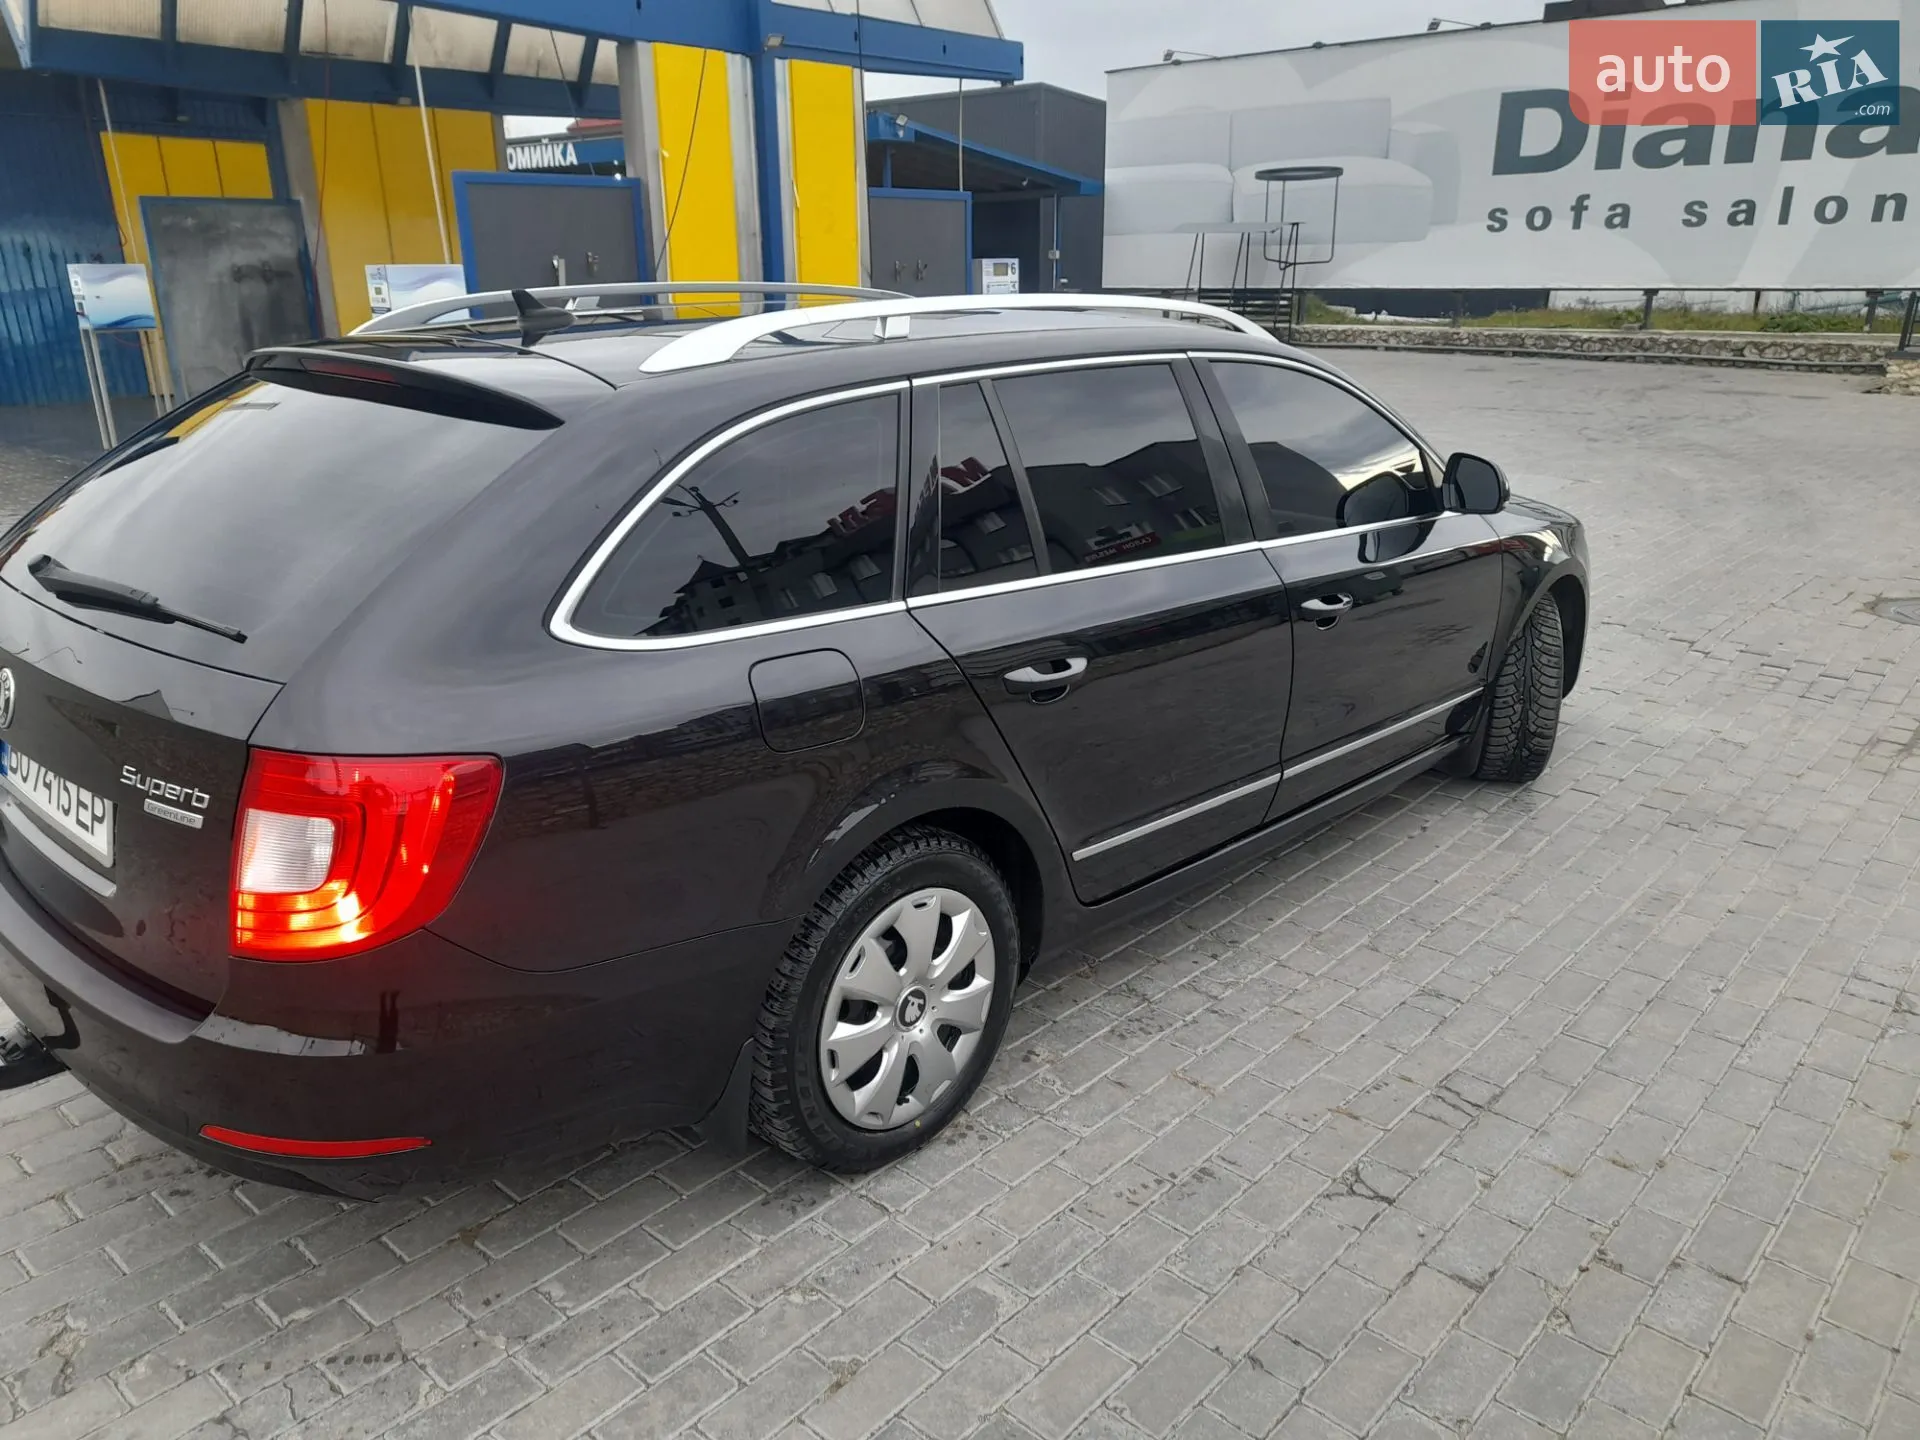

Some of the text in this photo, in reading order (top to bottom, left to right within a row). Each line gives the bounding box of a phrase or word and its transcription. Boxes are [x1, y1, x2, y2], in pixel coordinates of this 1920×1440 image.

[1492, 83, 1920, 176] Diana
[506, 138, 578, 171] ОМИЙКА
[1486, 186, 1908, 233] sofa salon
[120, 765, 210, 809] Superb
[75, 785, 106, 837] EP
